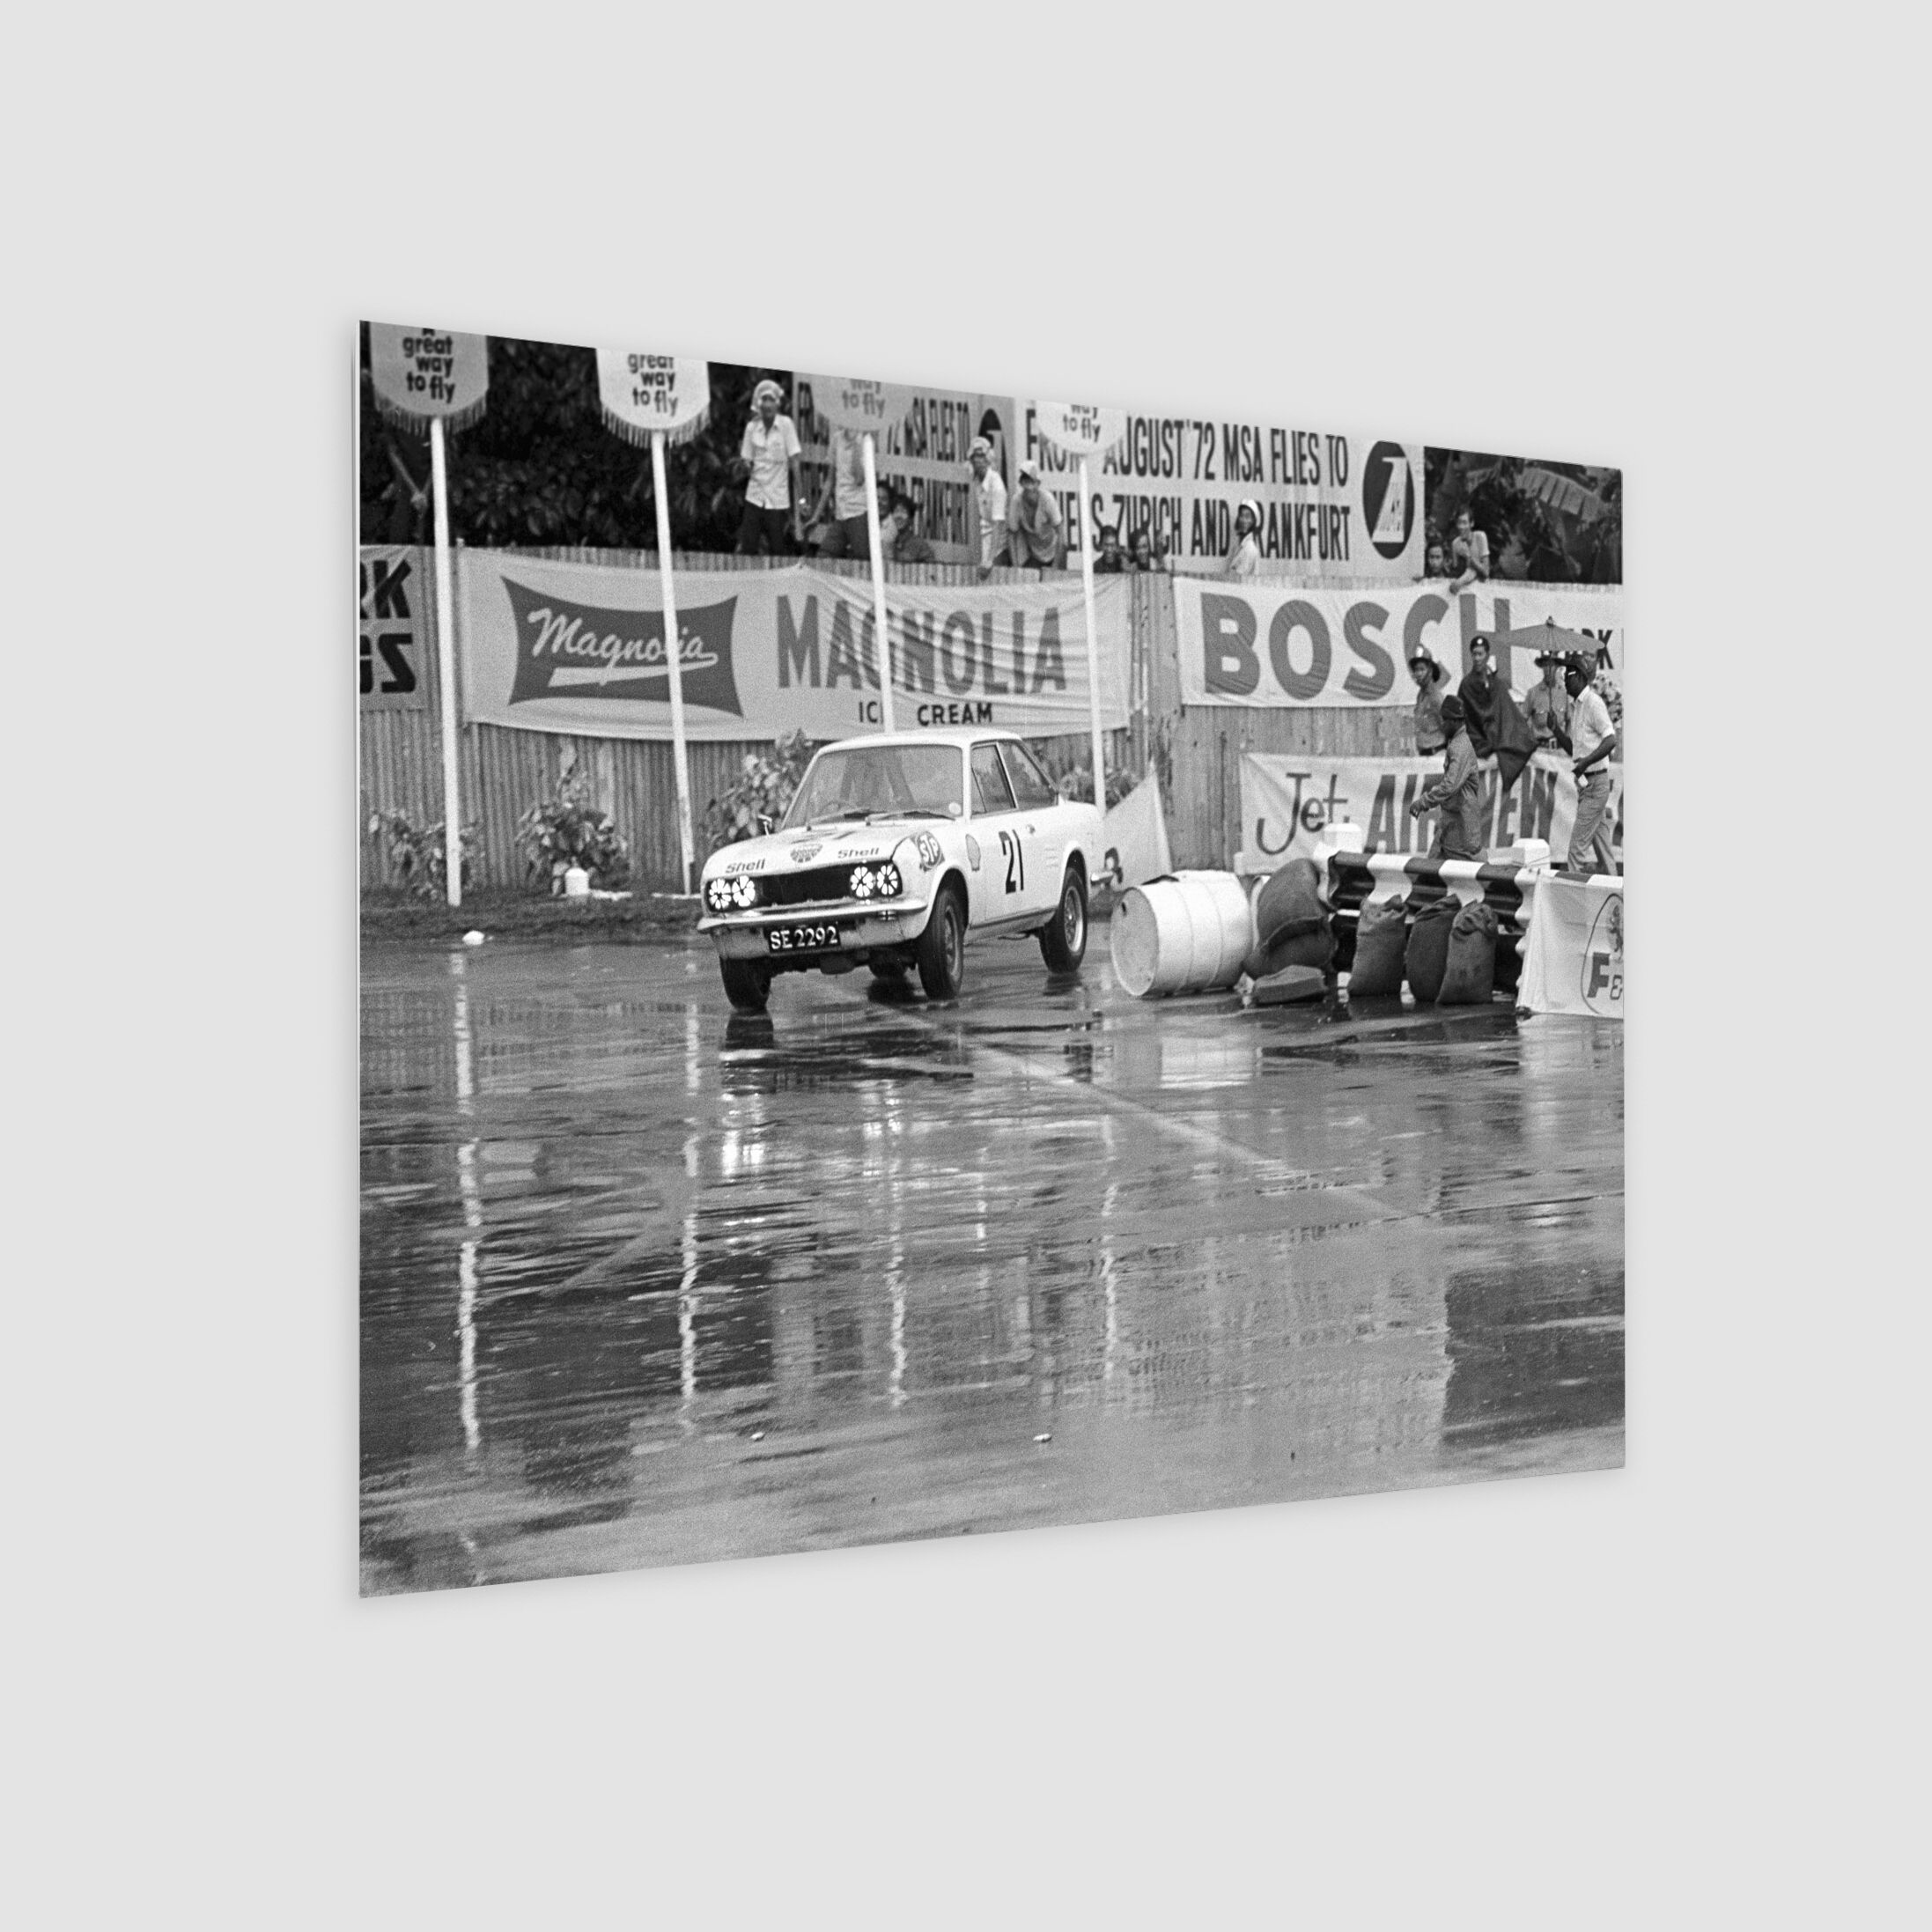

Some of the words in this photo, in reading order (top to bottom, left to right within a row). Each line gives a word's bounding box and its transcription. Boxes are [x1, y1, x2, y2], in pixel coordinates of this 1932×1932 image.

[402, 336, 453, 358] great
[416, 356, 454, 379] way
[628, 353, 674, 374] great
[406, 371, 426, 393] to
[429, 374, 455, 404] fly
[640, 371, 675, 392] way
[632, 387, 651, 406] to
[654, 389, 678, 417] fly
[842, 390, 859, 410] to
[863, 392, 886, 419] fly
[1063, 413, 1078, 432] to
[1081, 417, 1101, 443] fly
[1222, 423, 1264, 483] MSA
[1270, 428, 1320, 486] FLIES
[1325, 434, 1349, 487] TO
[1191, 498, 1230, 557] AND
[1251, 501, 1350, 561] RANKFURT
[527, 607, 719, 687] Magnoia
[777, 594, 1067, 696] MAGNOLIA
[1200, 592, 1513, 701] BOSCH
[859, 701, 883, 724] IC
[917, 703, 992, 726] CREAM
[837, 847, 880, 859] Shell
[919, 835, 940, 863] STP
[998, 830, 1024, 895] 21
[725, 859, 766, 874] Shell
[771, 929, 793, 949] SE
[793, 925, 838, 948] 2292
